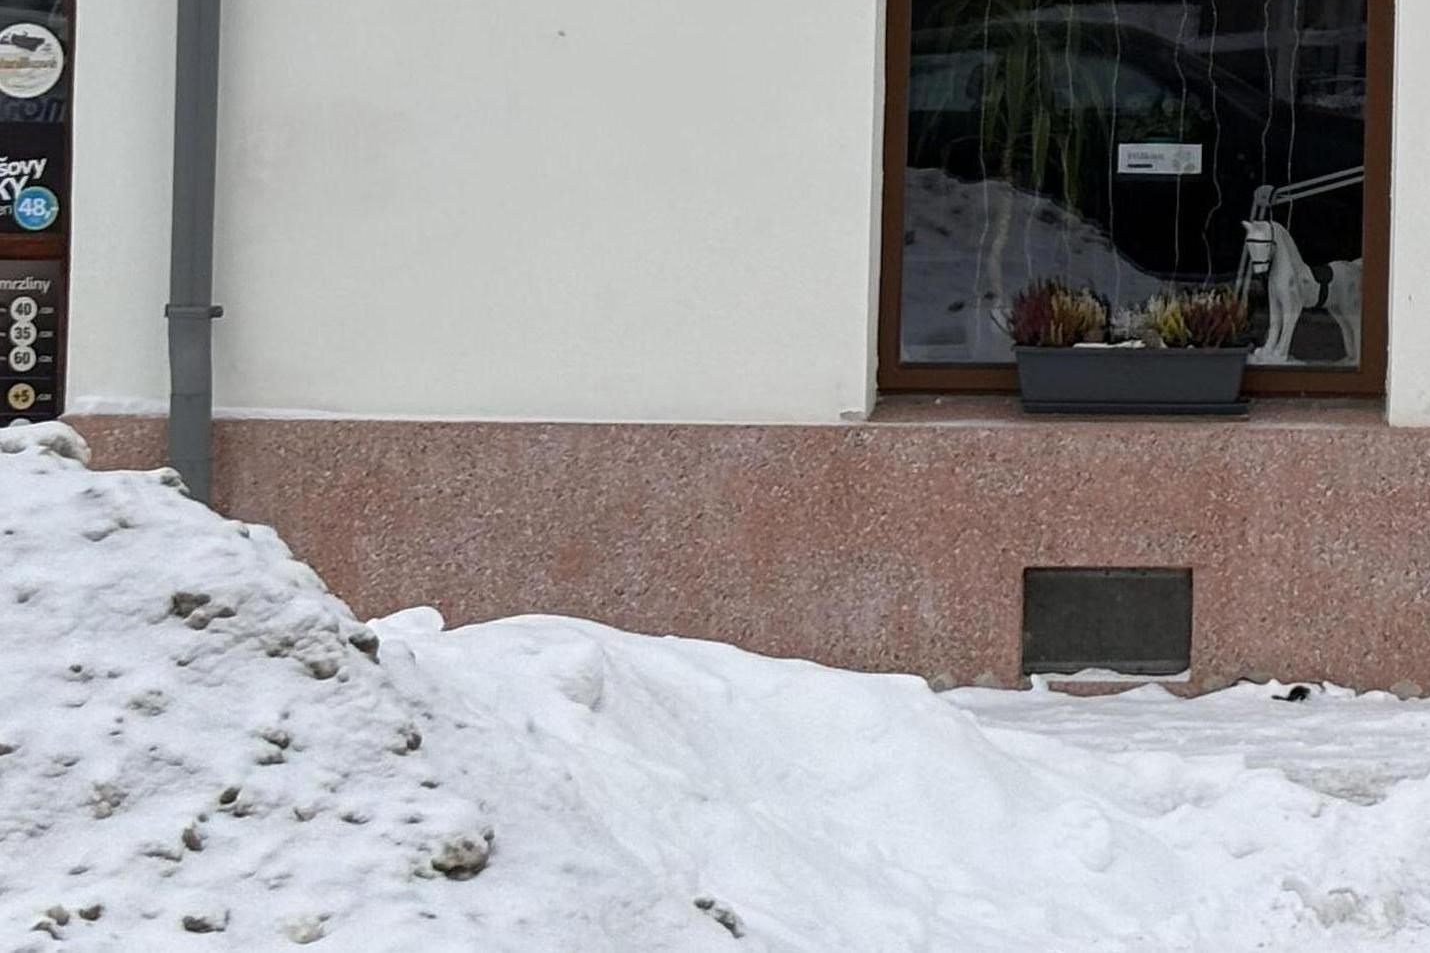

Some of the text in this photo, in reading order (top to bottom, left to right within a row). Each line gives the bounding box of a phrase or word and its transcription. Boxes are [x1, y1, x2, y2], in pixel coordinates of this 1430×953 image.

[15, 303, 32, 315] 40
[14, 327, 31, 340] 35
[14, 351, 31, 364] 60
